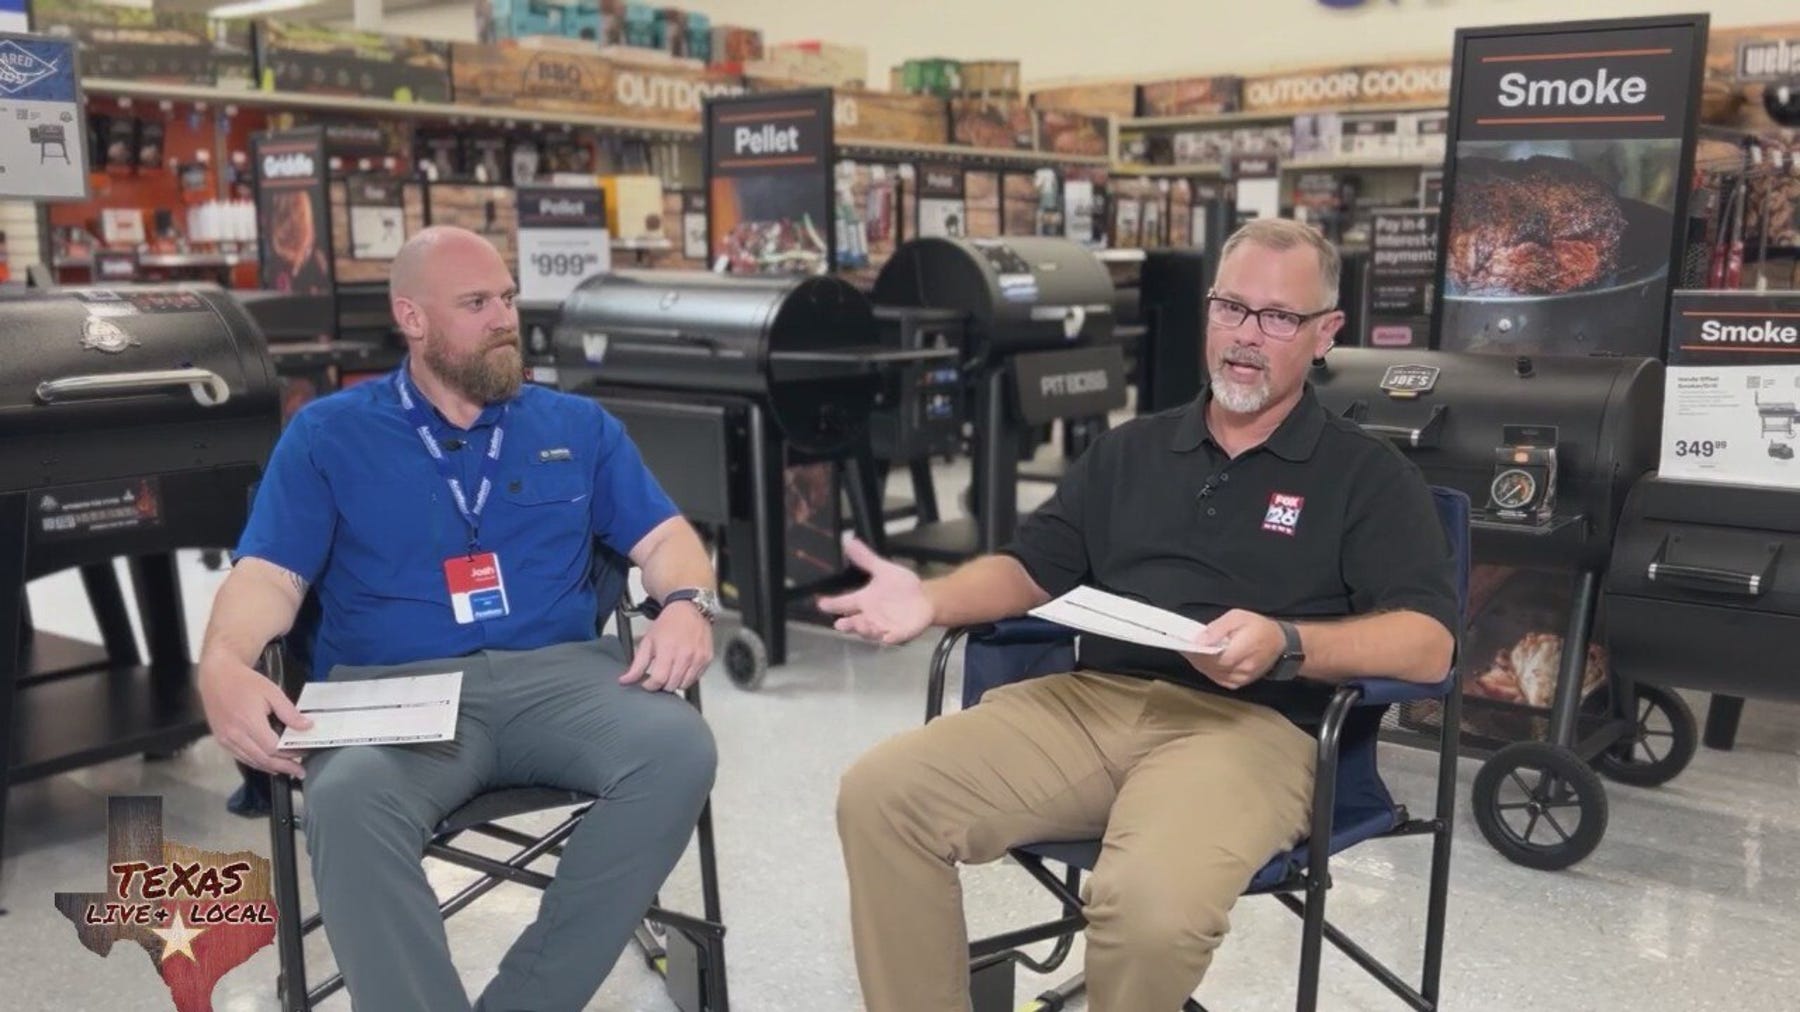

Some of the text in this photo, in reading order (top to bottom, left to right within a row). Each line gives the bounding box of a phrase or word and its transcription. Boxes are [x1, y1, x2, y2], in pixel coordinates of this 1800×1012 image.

[1746, 39, 1800, 74] webe
[1249, 65, 1451, 104] OUTDOOR COOKI
[1498, 68, 1647, 107] Smoke
[735, 124, 799, 155] Pellet
[1701, 320, 1797, 343] Smoke
[1389, 374, 1429, 386] JOE'S
[1274, 494, 1300, 508] FOX
[1266, 506, 1298, 527] 26
